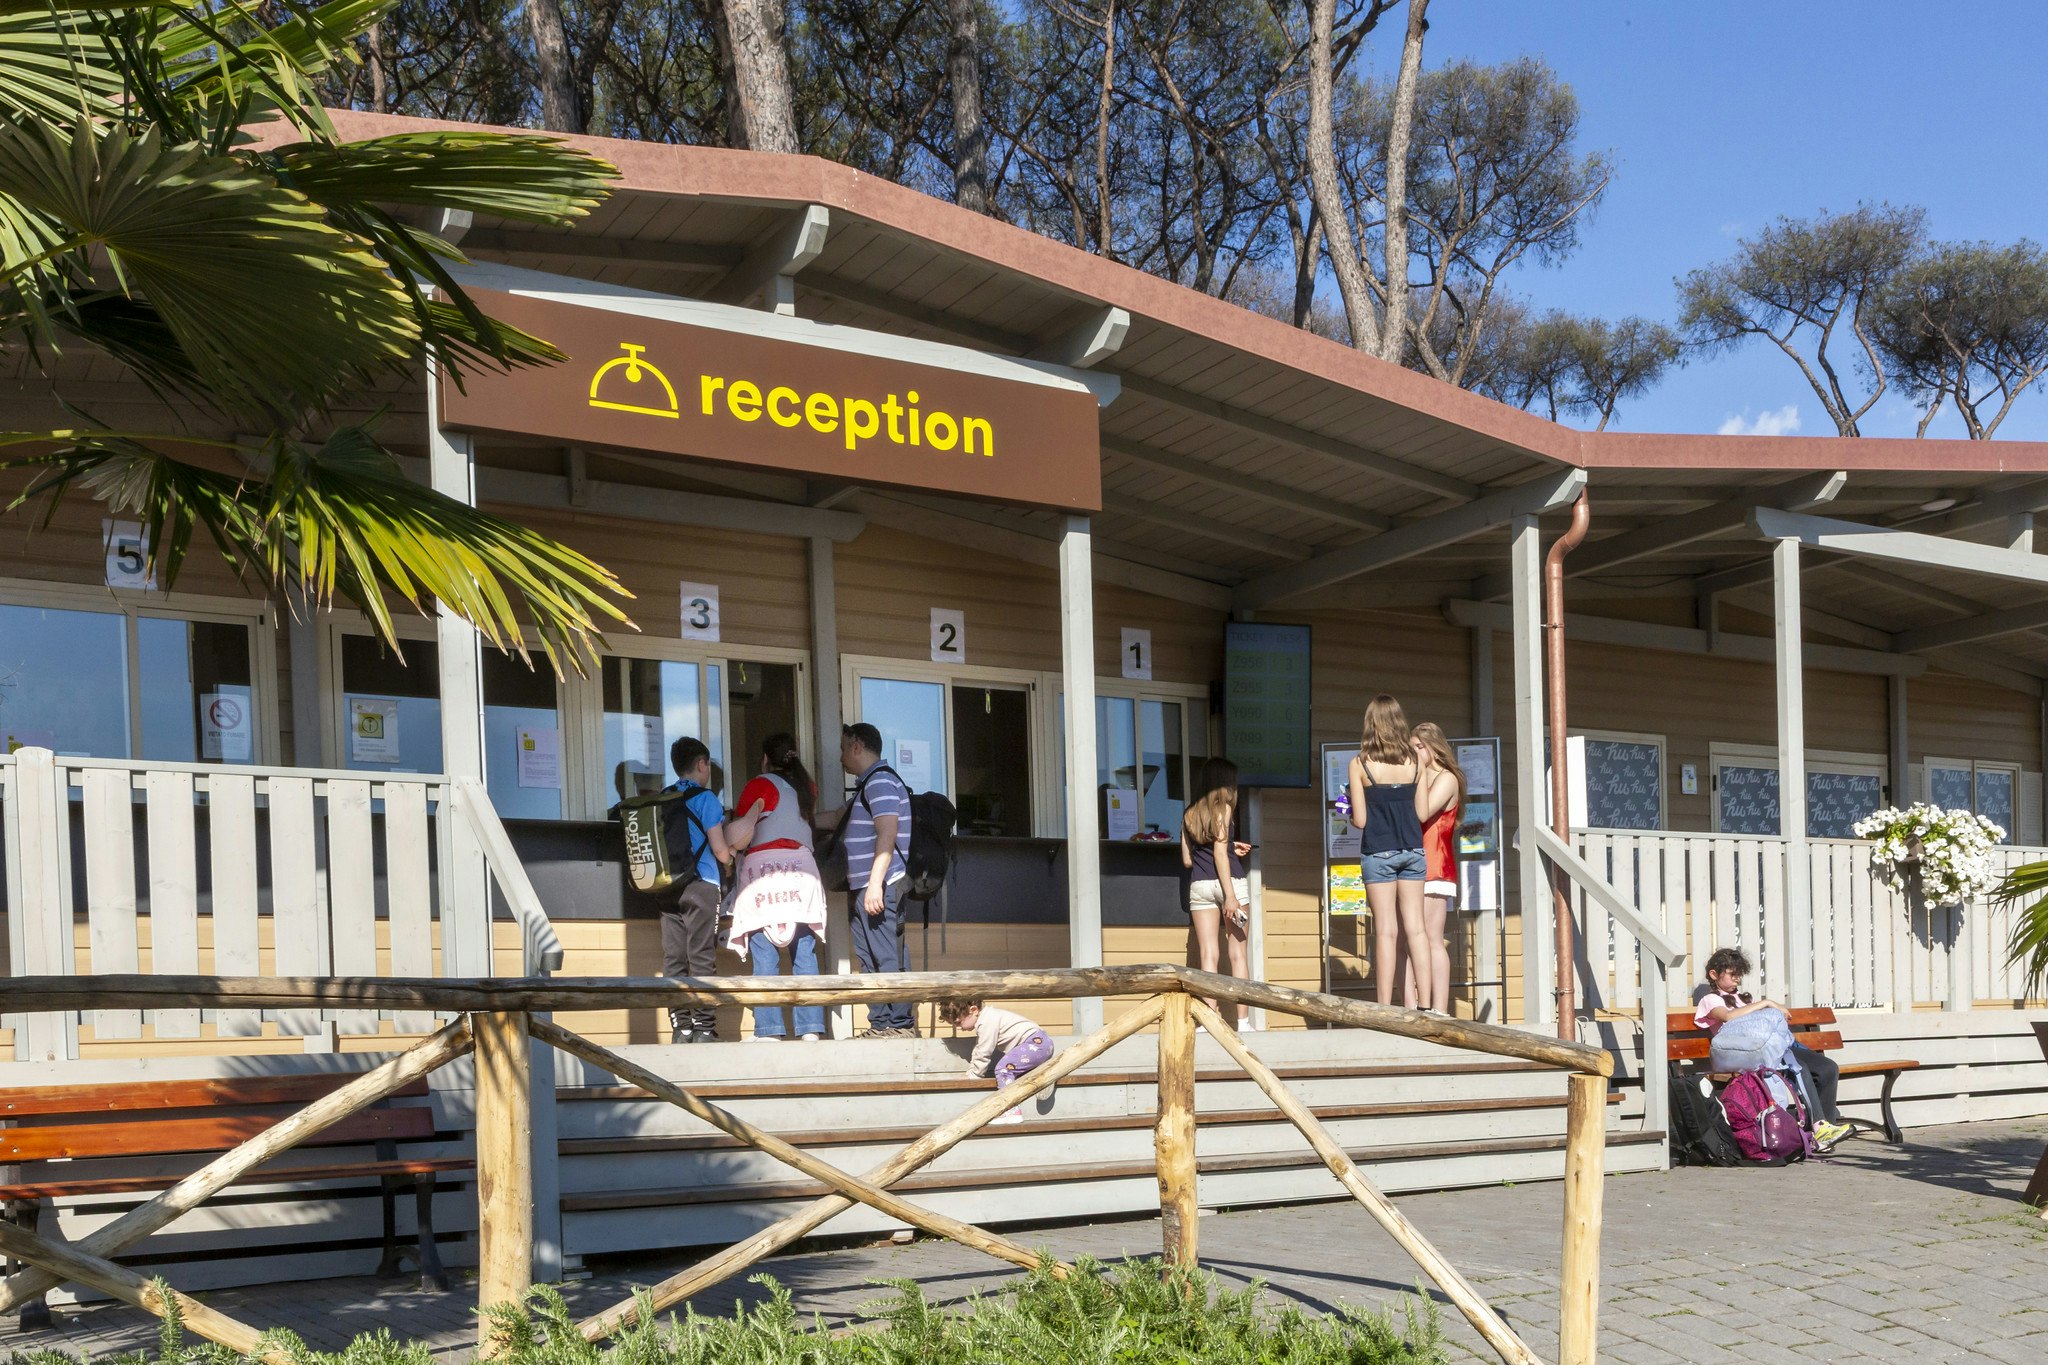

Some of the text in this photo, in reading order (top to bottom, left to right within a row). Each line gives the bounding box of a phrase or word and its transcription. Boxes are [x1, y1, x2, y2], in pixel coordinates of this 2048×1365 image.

[700, 374, 994, 457] reception
[117, 538, 144, 574] 5
[690, 598, 710, 629] 3
[939, 623, 957, 653] 2
[1231, 632, 1264, 642] TICKET
[1129, 642, 1141, 669] 1
[628, 810, 643, 864] NORTH
[639, 832, 655, 863] THE
[755, 890, 802, 908] PINK
